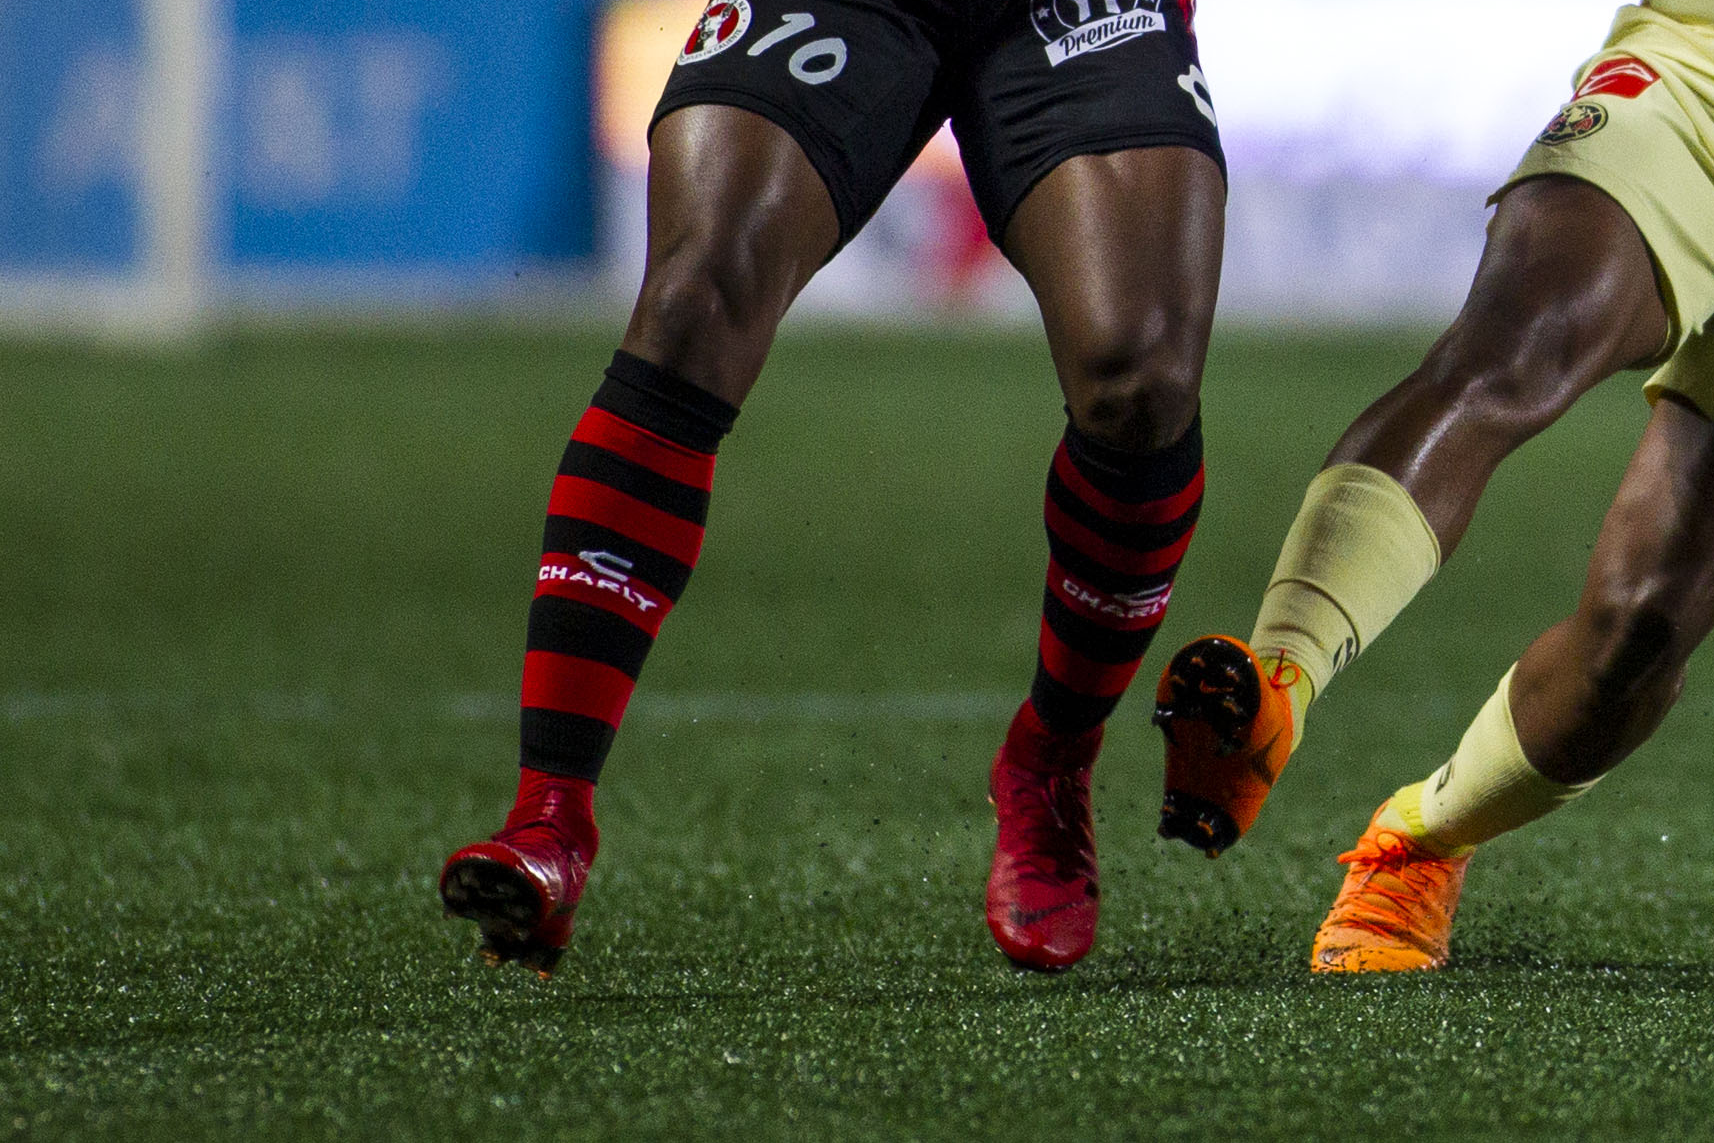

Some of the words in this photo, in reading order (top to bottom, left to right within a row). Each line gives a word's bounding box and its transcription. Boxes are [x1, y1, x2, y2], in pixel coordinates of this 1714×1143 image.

[747, 13, 848, 85] 10
[1059, 14, 1155, 57] Premium
[538, 565, 658, 612] CHARLY
